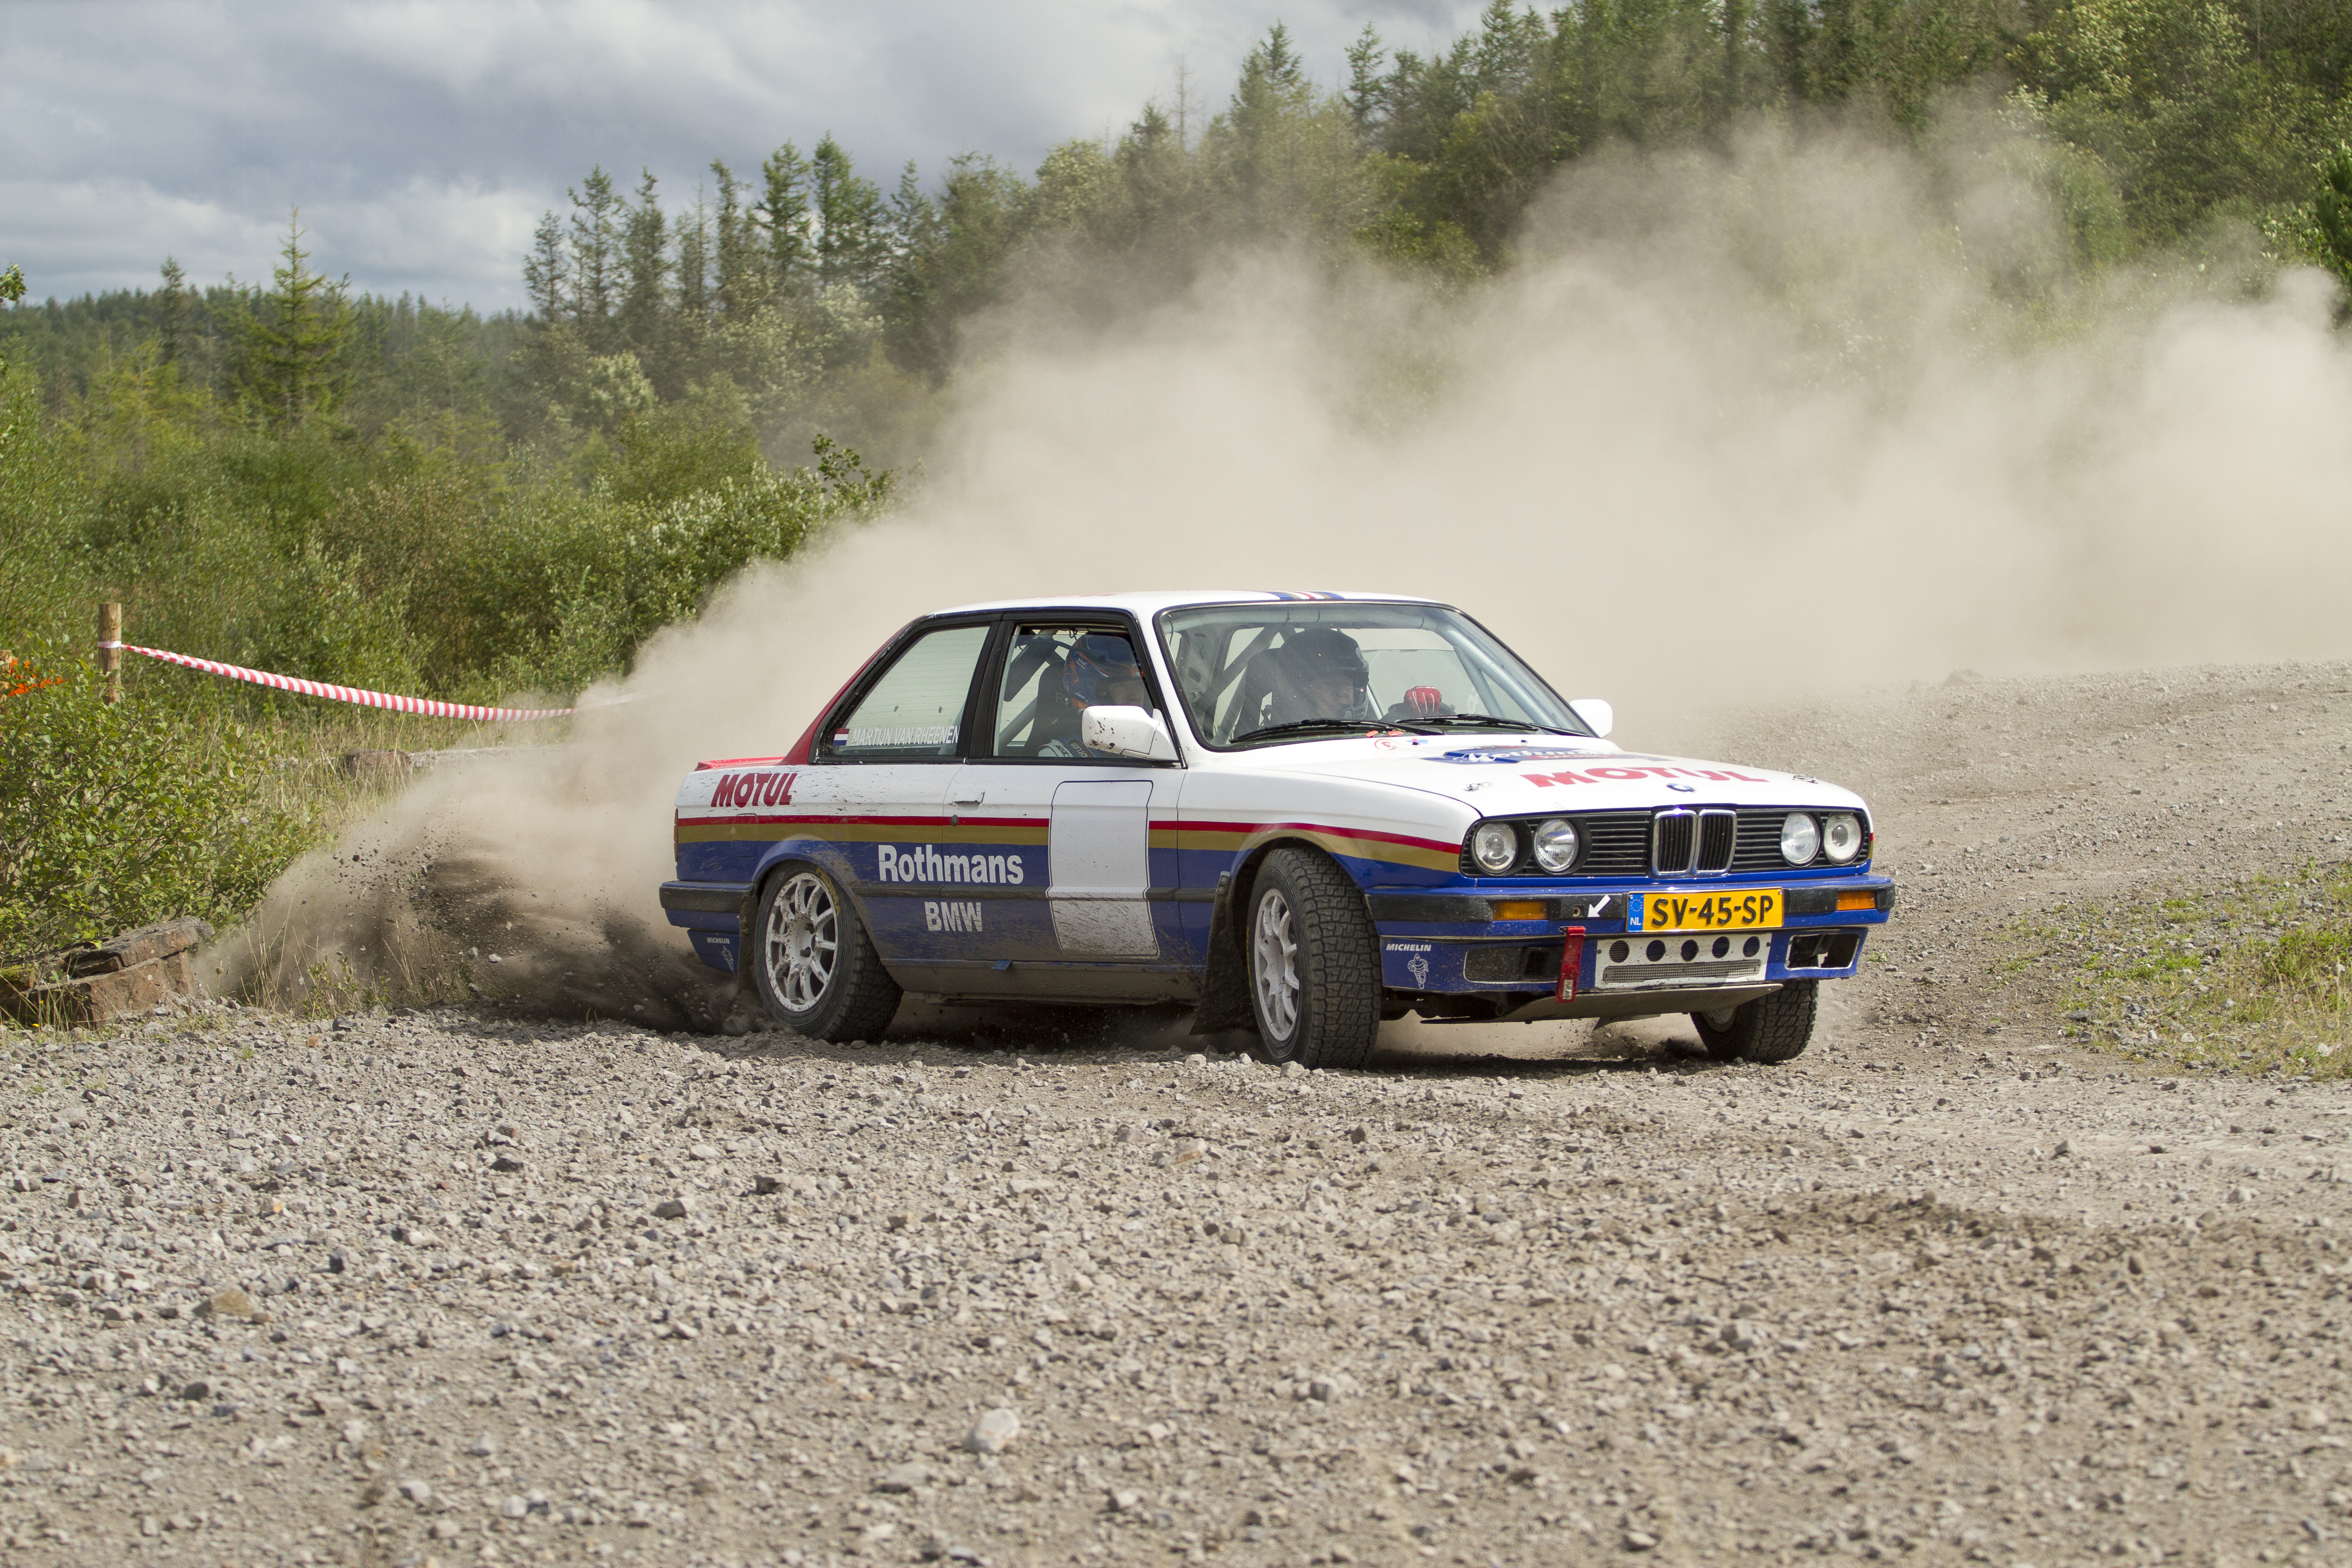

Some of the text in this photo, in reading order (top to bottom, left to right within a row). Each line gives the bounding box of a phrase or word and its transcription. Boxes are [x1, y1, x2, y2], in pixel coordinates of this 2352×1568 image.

[851, 725, 959, 746] MARTIJN VAN RHEENEN
[710, 773, 798, 808] MOTUL
[1520, 767, 1770, 787] MOTUL
[878, 844, 1024, 884] Rothmans
[924, 902, 983, 932] BMW
[1630, 916, 1642, 926] NL
[1652, 895, 1774, 926] SV-45-SP
